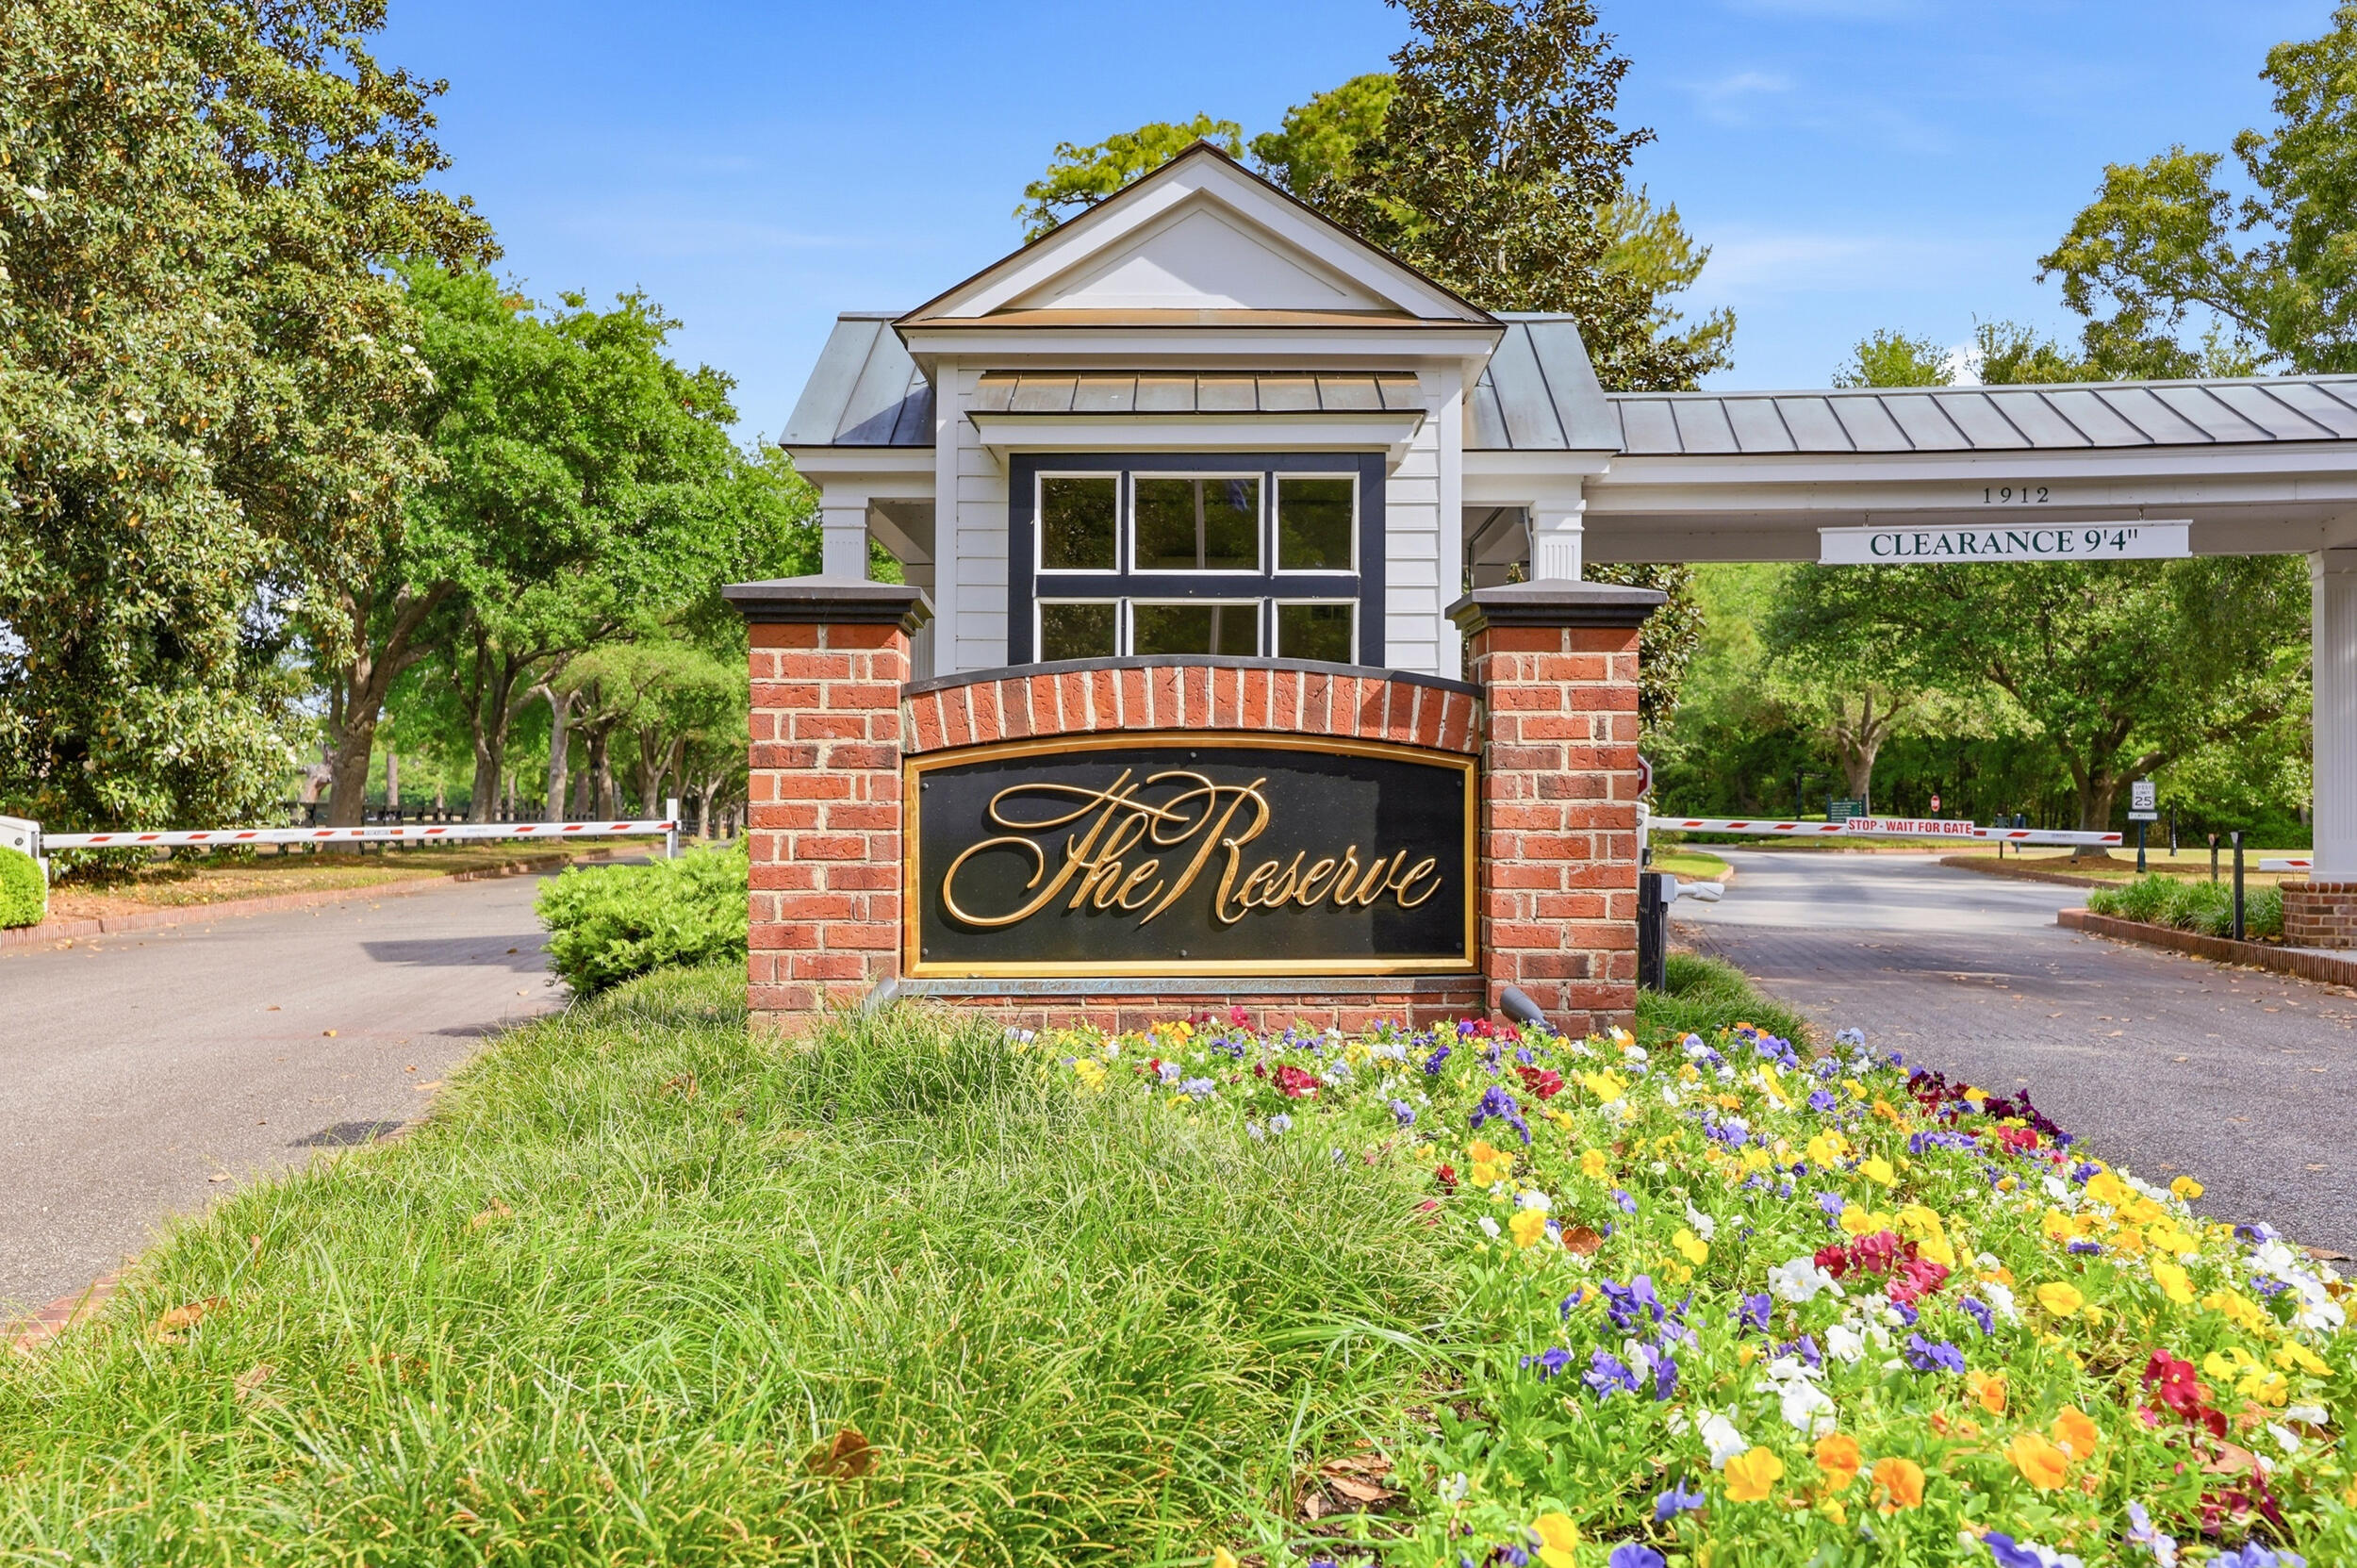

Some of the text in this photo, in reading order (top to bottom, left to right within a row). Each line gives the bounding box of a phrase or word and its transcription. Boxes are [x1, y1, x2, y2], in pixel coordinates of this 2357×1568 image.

[1983, 487, 2050, 504] 1912
[1870, 528, 2138, 556] CLEARANCE 9'4"
[2134, 796, 2152, 806] 25
[1848, 819, 1877, 831] STOP
[1886, 820, 1914, 832] WAIT
[1919, 822, 1940, 833] FOR
[1944, 822, 1972, 834] GATE
[943, 767, 1442, 926] The Reserve
